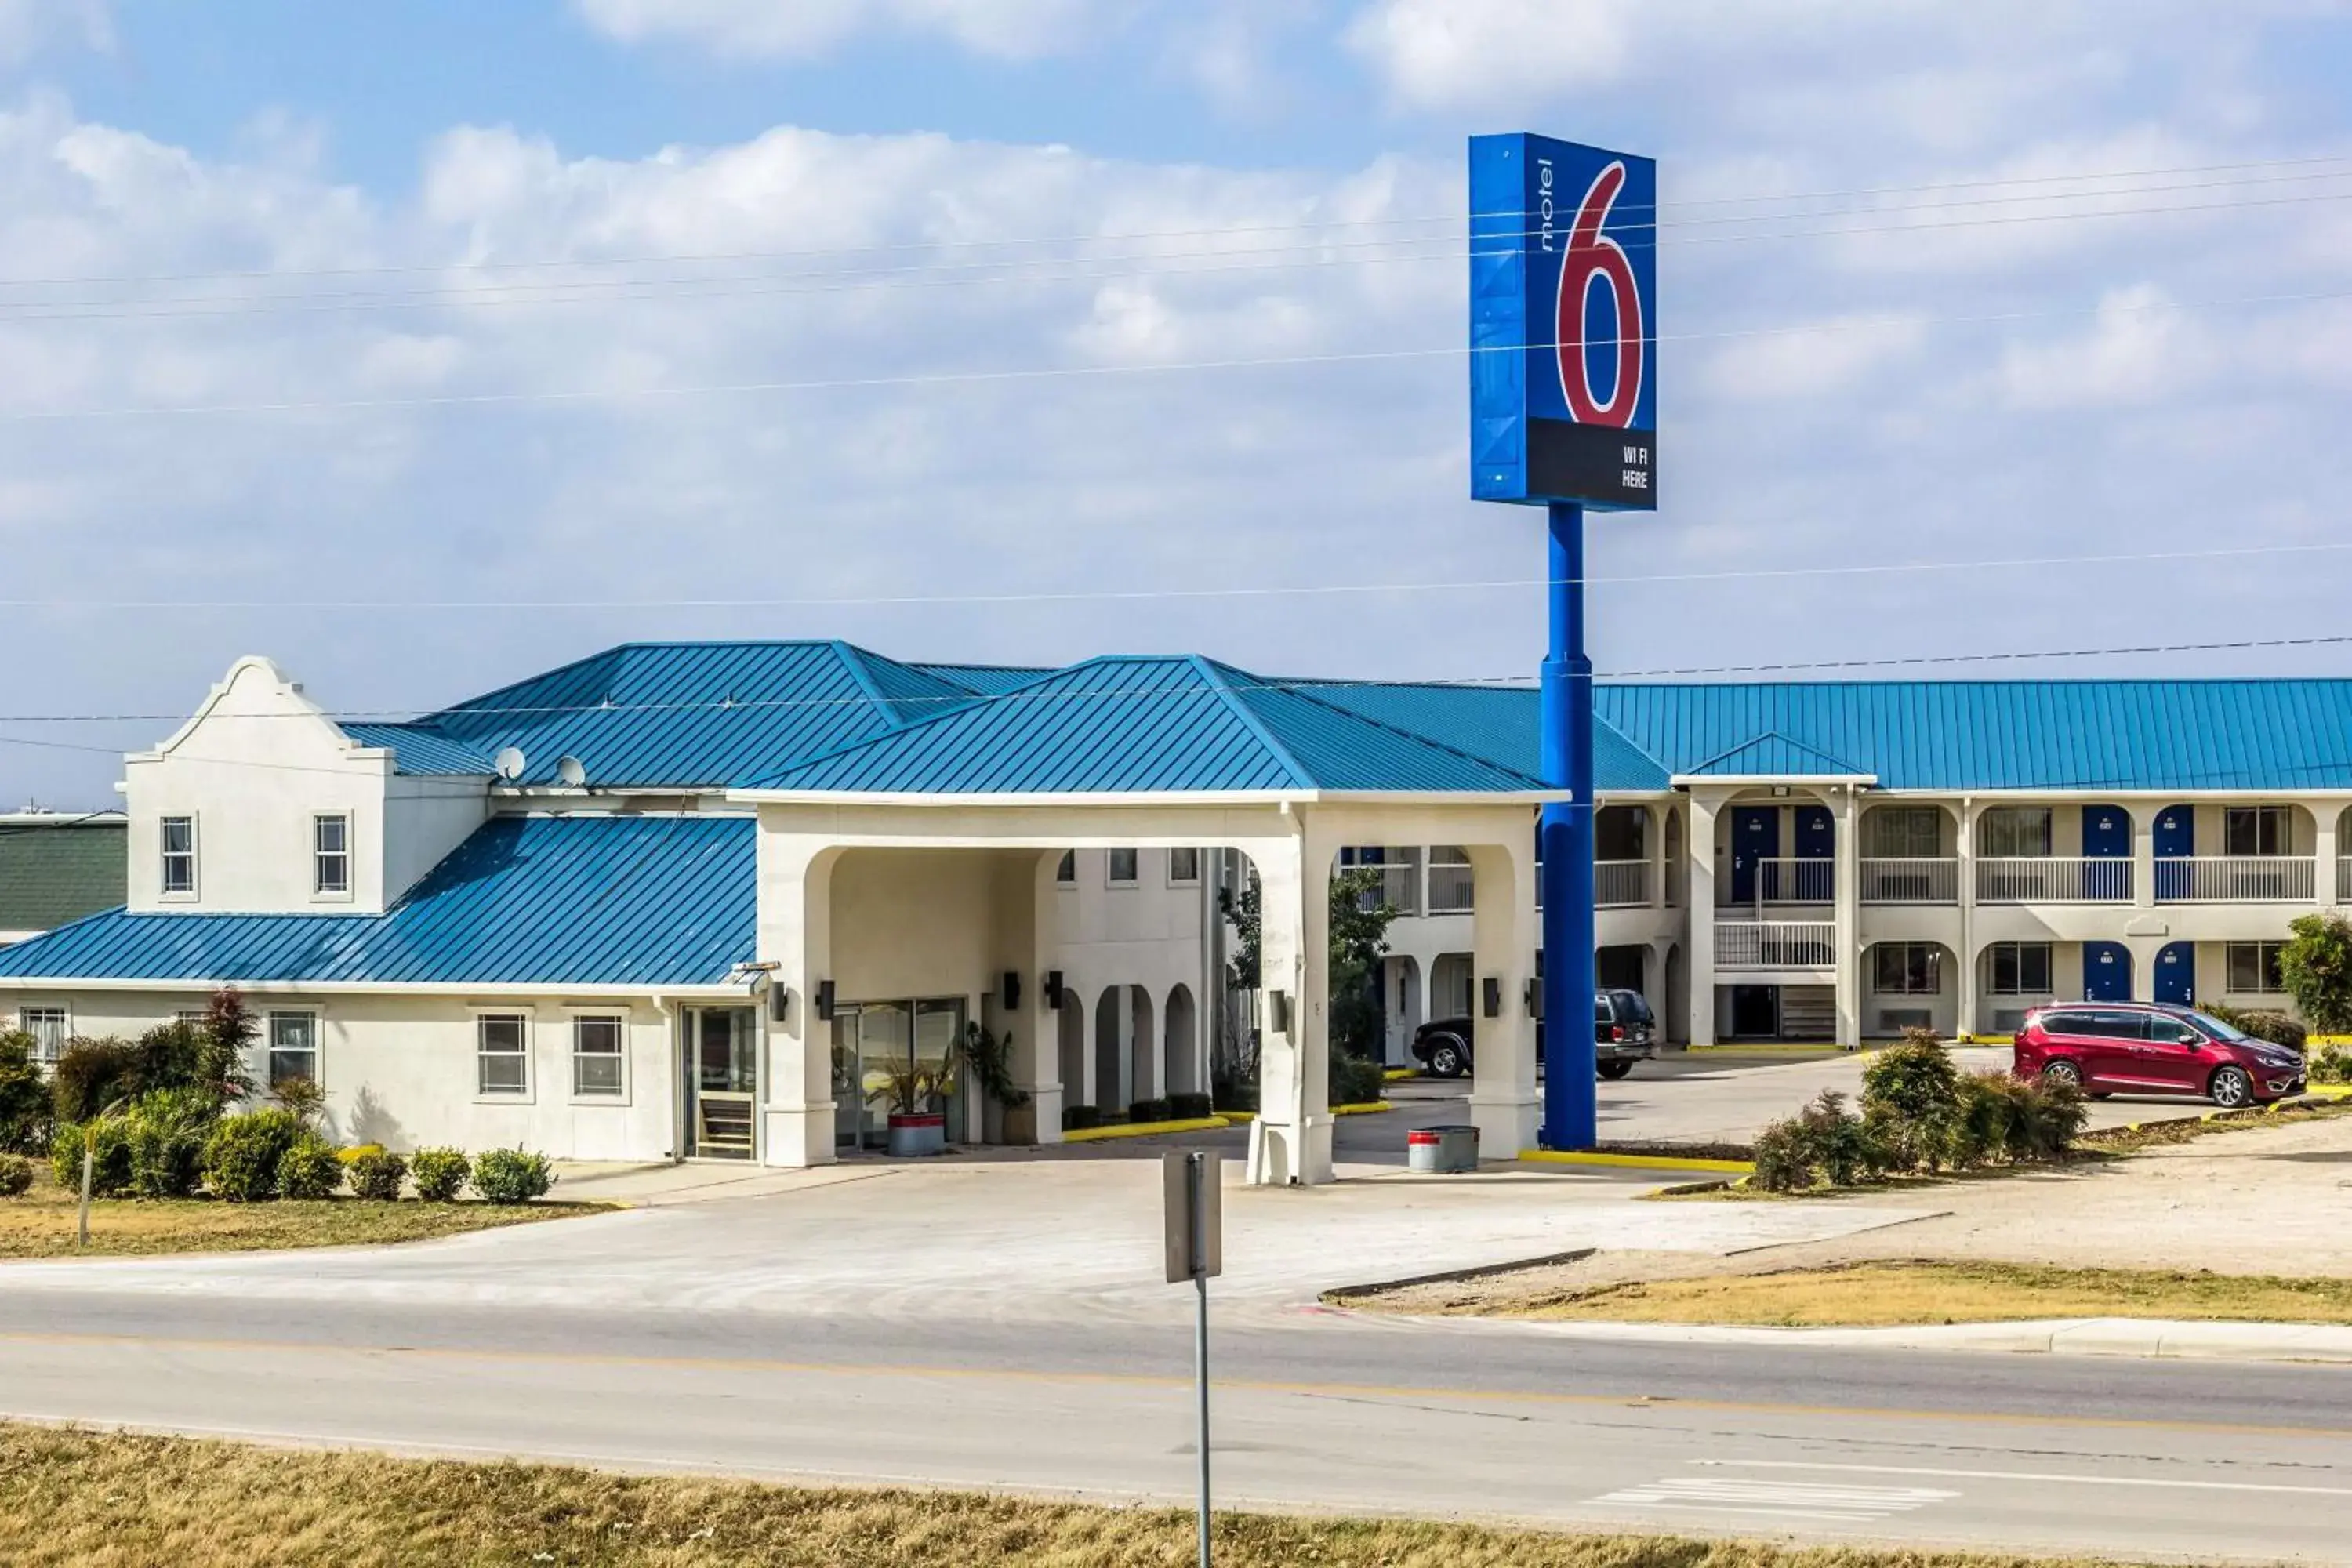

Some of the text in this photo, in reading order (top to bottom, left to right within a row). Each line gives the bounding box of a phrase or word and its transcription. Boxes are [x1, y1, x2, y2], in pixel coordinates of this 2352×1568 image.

[1537, 158, 1553, 252] motel
[1555, 160, 1643, 428] 6
[1624, 446, 1647, 465] WI FI
[1622, 470, 1647, 488] HERE
[1578, 1478, 1963, 1521] ONLY
